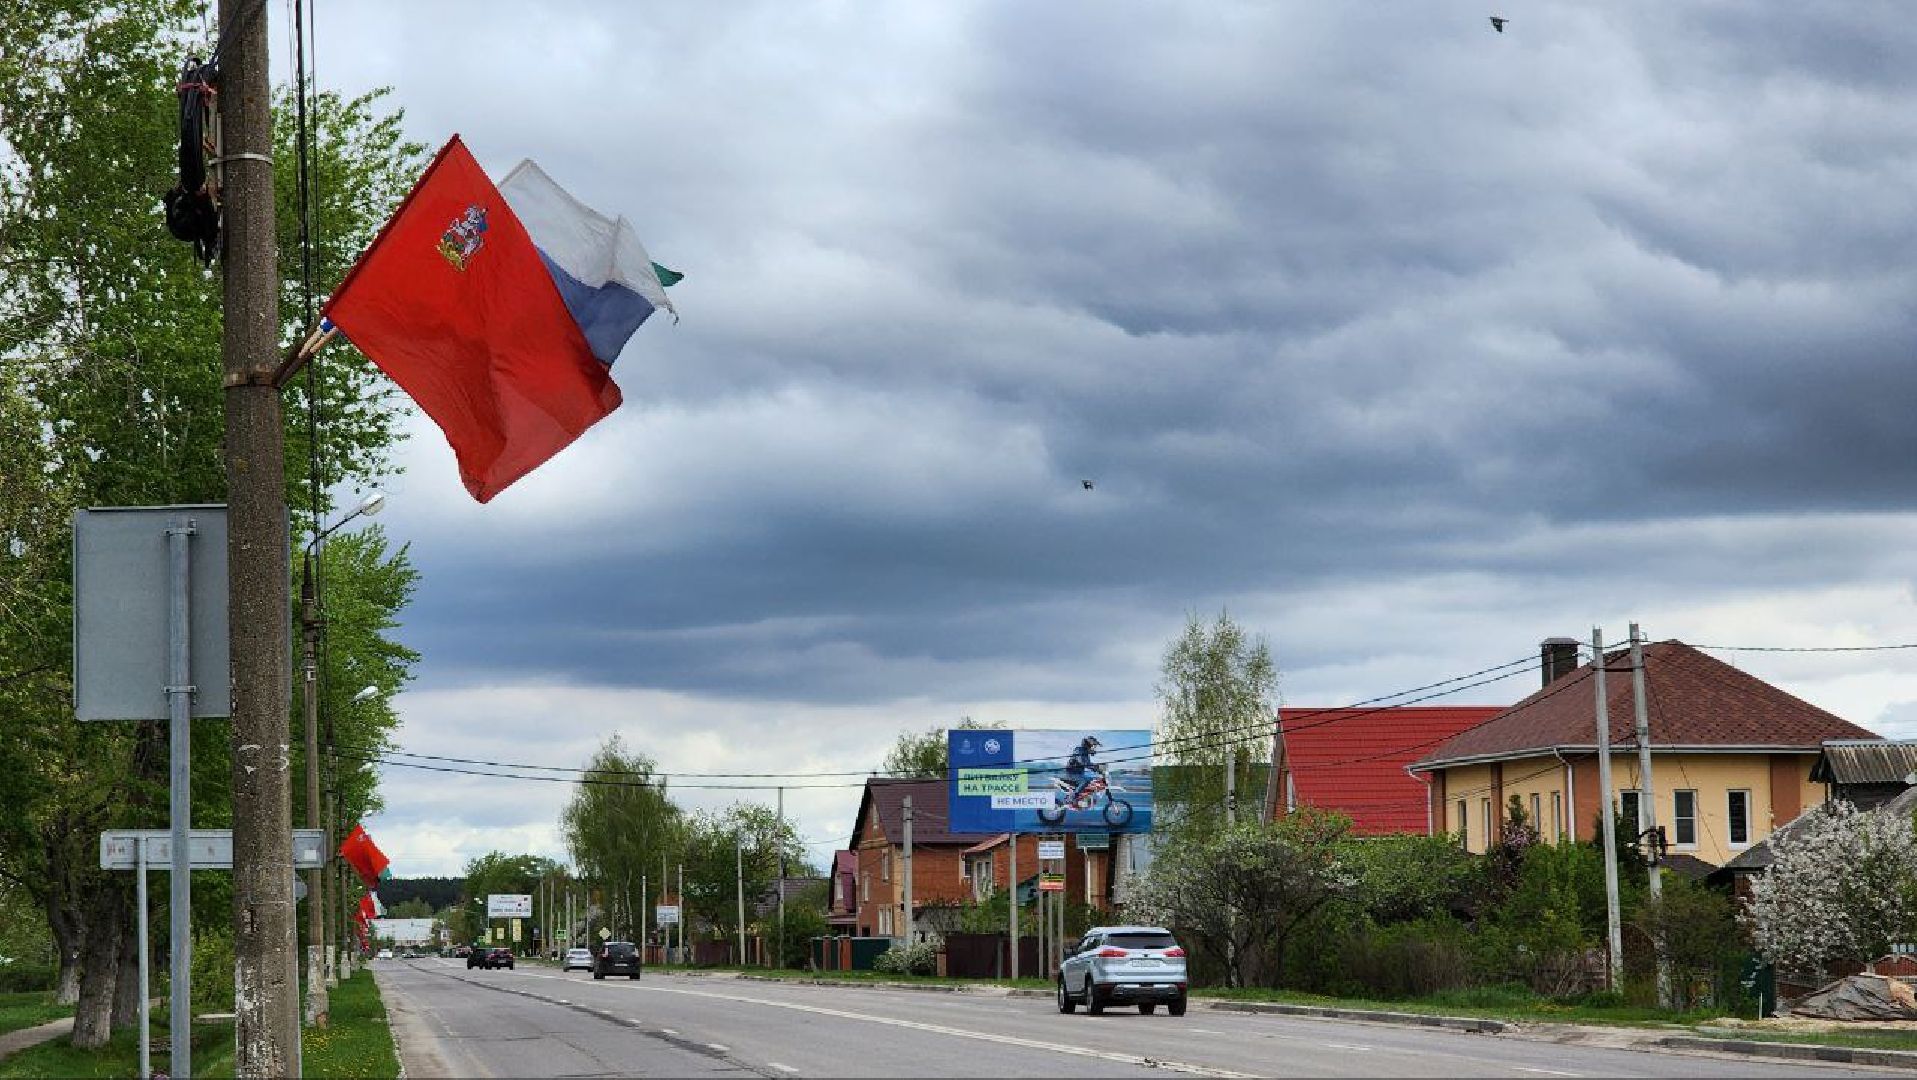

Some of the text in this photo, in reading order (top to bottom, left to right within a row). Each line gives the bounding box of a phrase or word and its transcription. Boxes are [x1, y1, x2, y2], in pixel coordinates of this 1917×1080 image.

[963, 783, 1020, 792] НА ТРАССЕ
[997, 797, 1047, 805] НЕ МЕСТО
